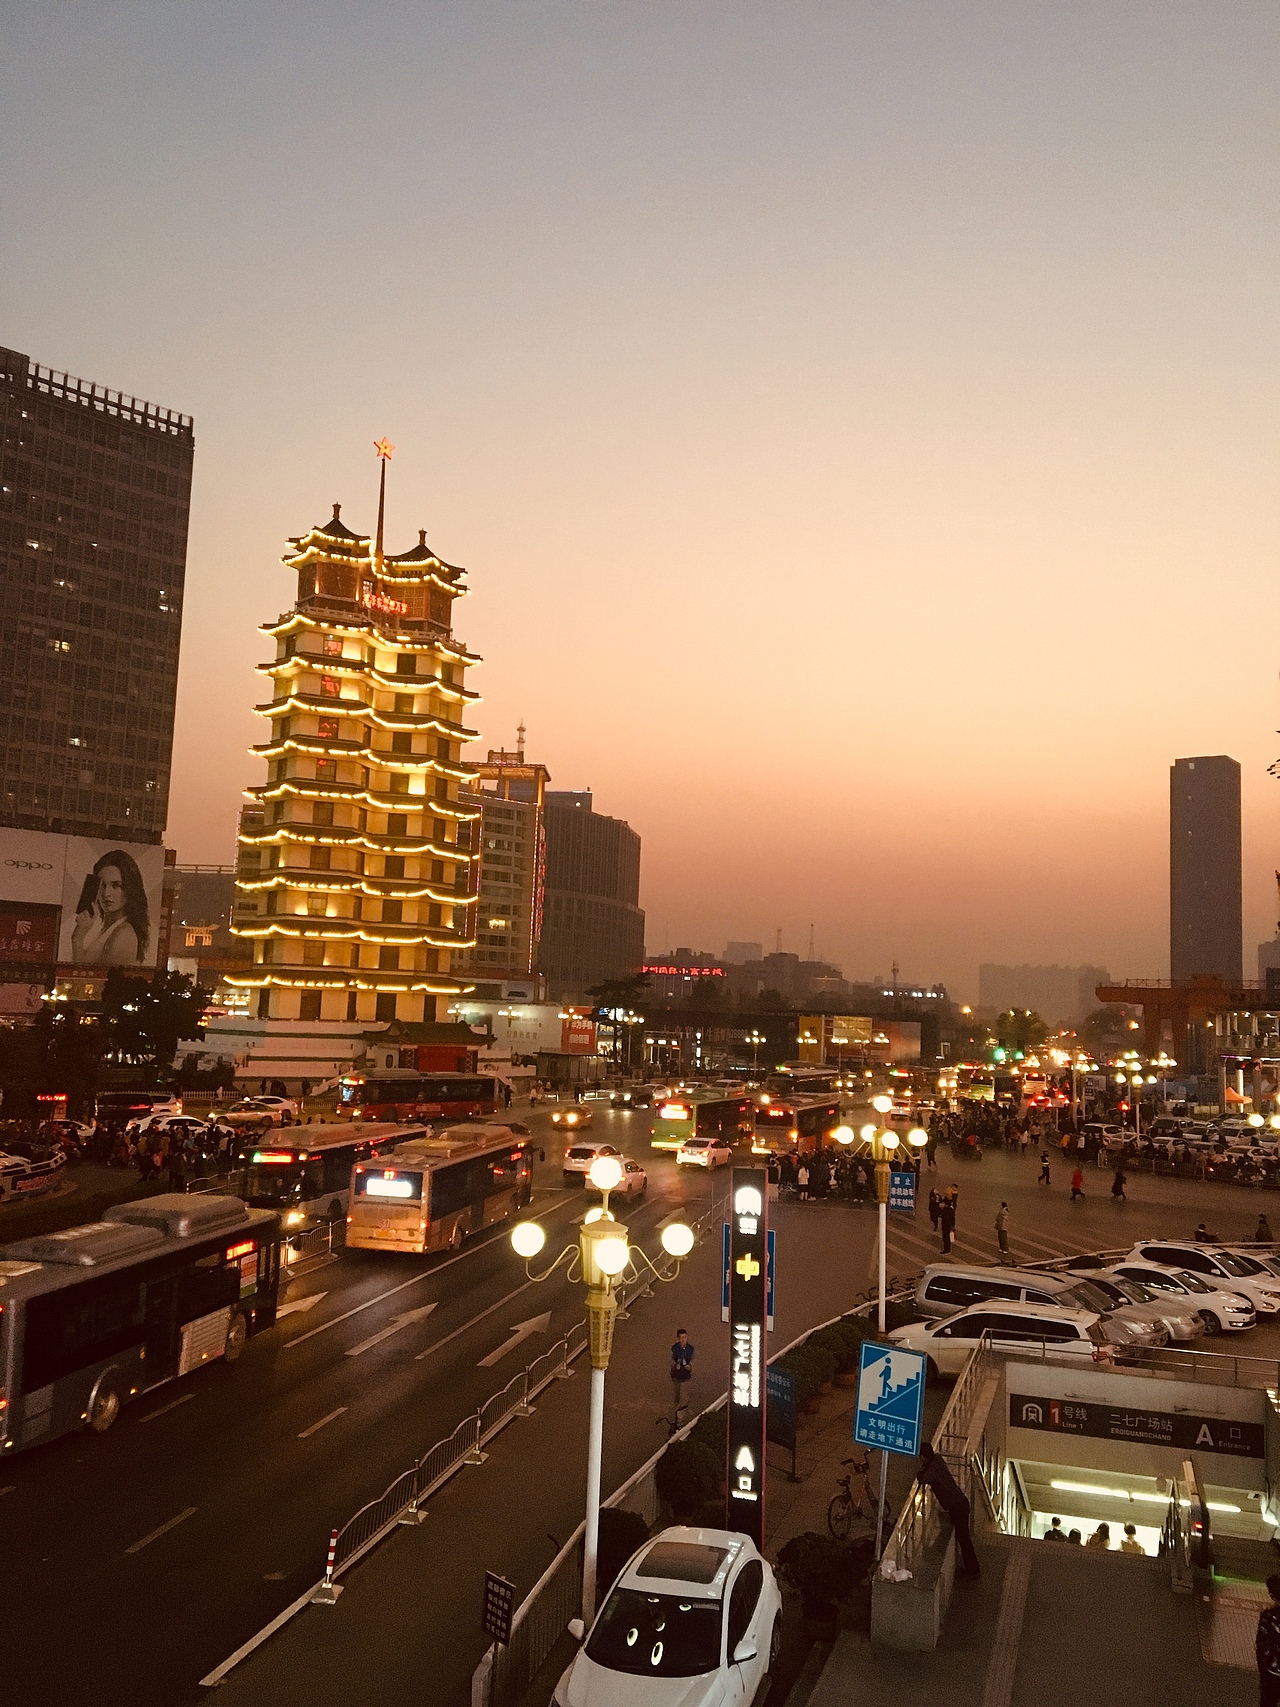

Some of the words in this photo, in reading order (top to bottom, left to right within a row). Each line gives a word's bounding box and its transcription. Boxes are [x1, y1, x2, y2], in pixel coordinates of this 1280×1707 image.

[868, 1418, 906, 1435] 文明出行
[1062, 1421, 1077, 1430] Line
[1109, 1413, 1173, 1432] 二七广场站
[1195, 1423, 1215, 1447] A
[1218, 1440, 1252, 1452] Entrance
